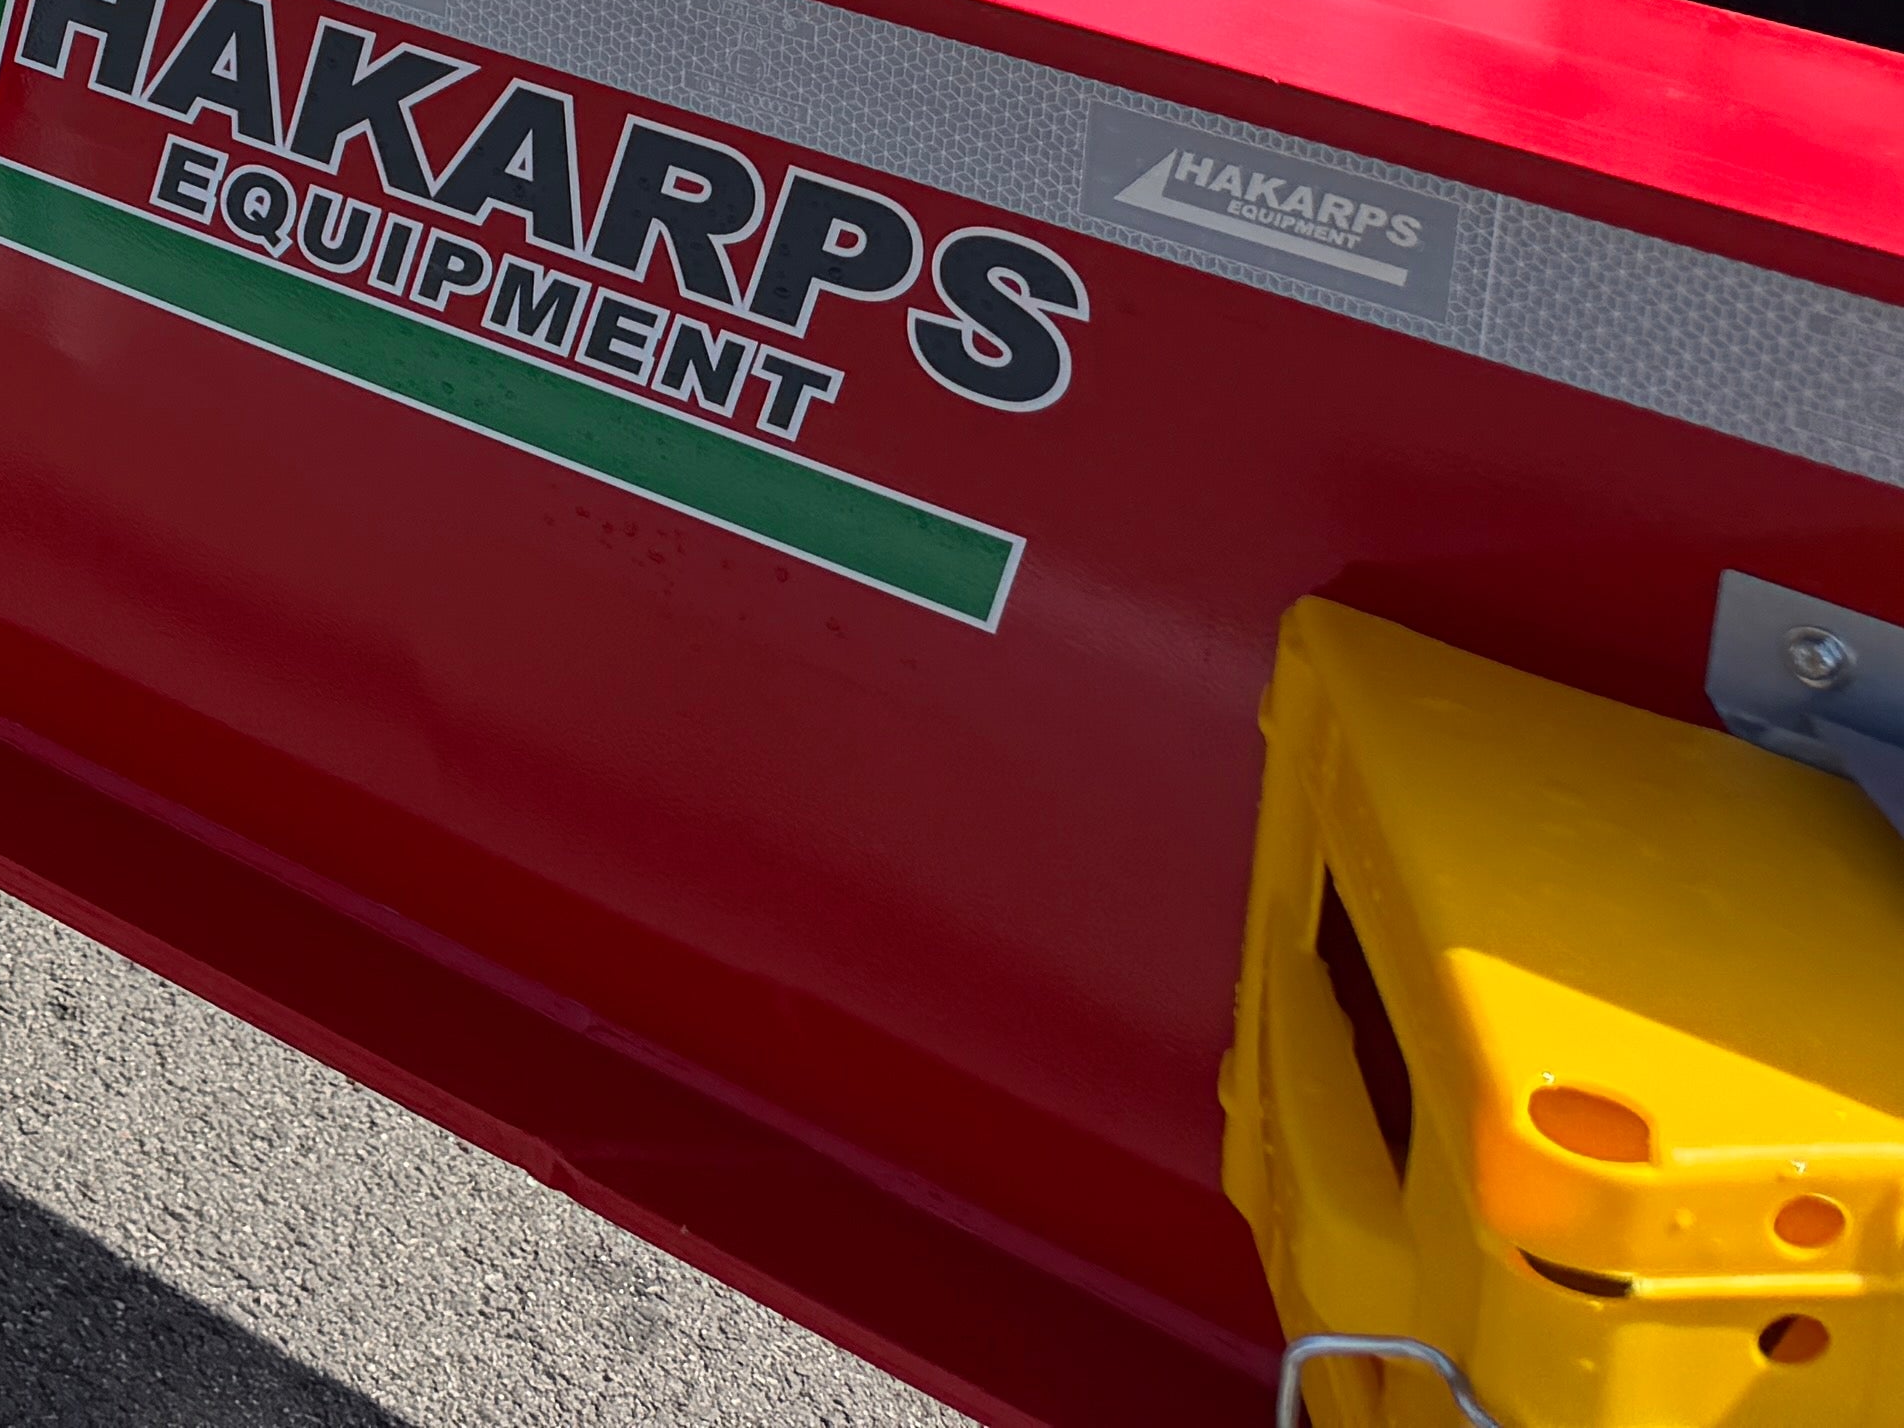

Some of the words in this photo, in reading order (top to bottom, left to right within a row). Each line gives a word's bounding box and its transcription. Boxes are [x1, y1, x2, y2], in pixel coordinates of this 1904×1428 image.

[1174, 151, 1423, 248] HAKARPS
[1227, 199, 1362, 250] EQUIPMENT
[149, 132, 844, 444] EQUIPMENT
